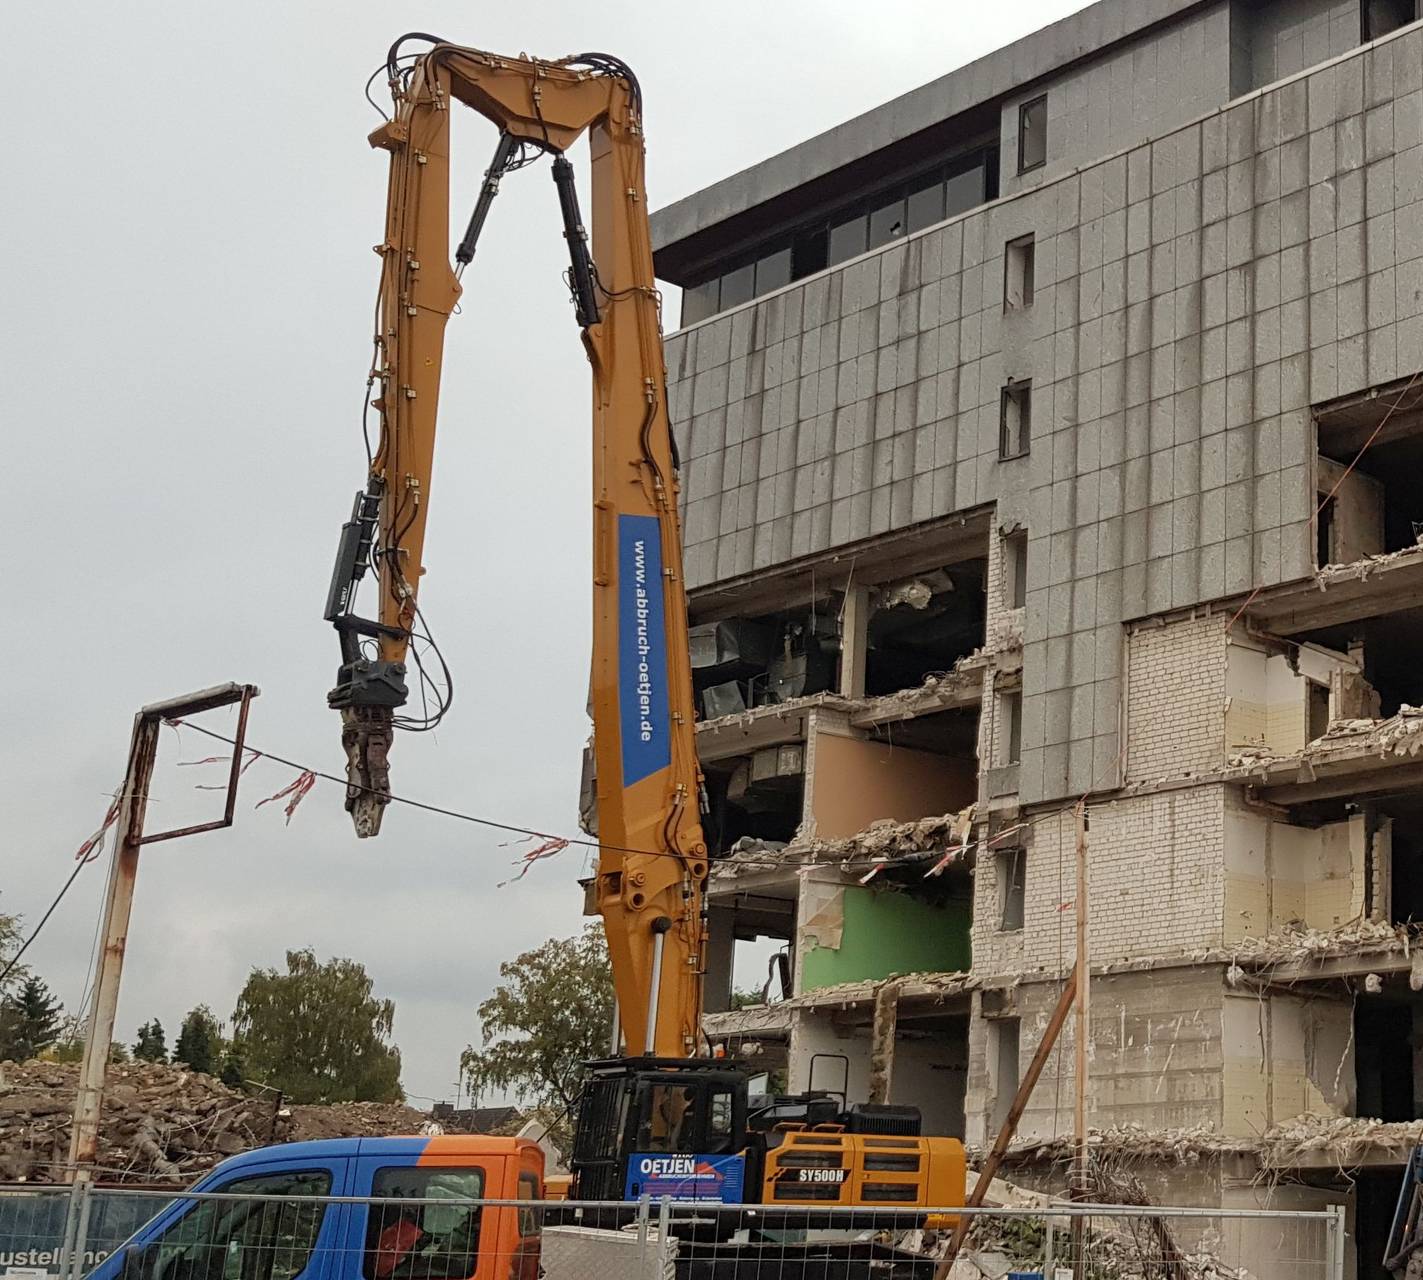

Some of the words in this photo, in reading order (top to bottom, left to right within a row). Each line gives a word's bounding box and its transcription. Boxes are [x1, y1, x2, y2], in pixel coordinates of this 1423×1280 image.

[634, 540, 653, 742] www.abbruch-oetjen.de
[640, 1158, 696, 1174] OETJEN
[799, 1168, 845, 1182] SY500H
